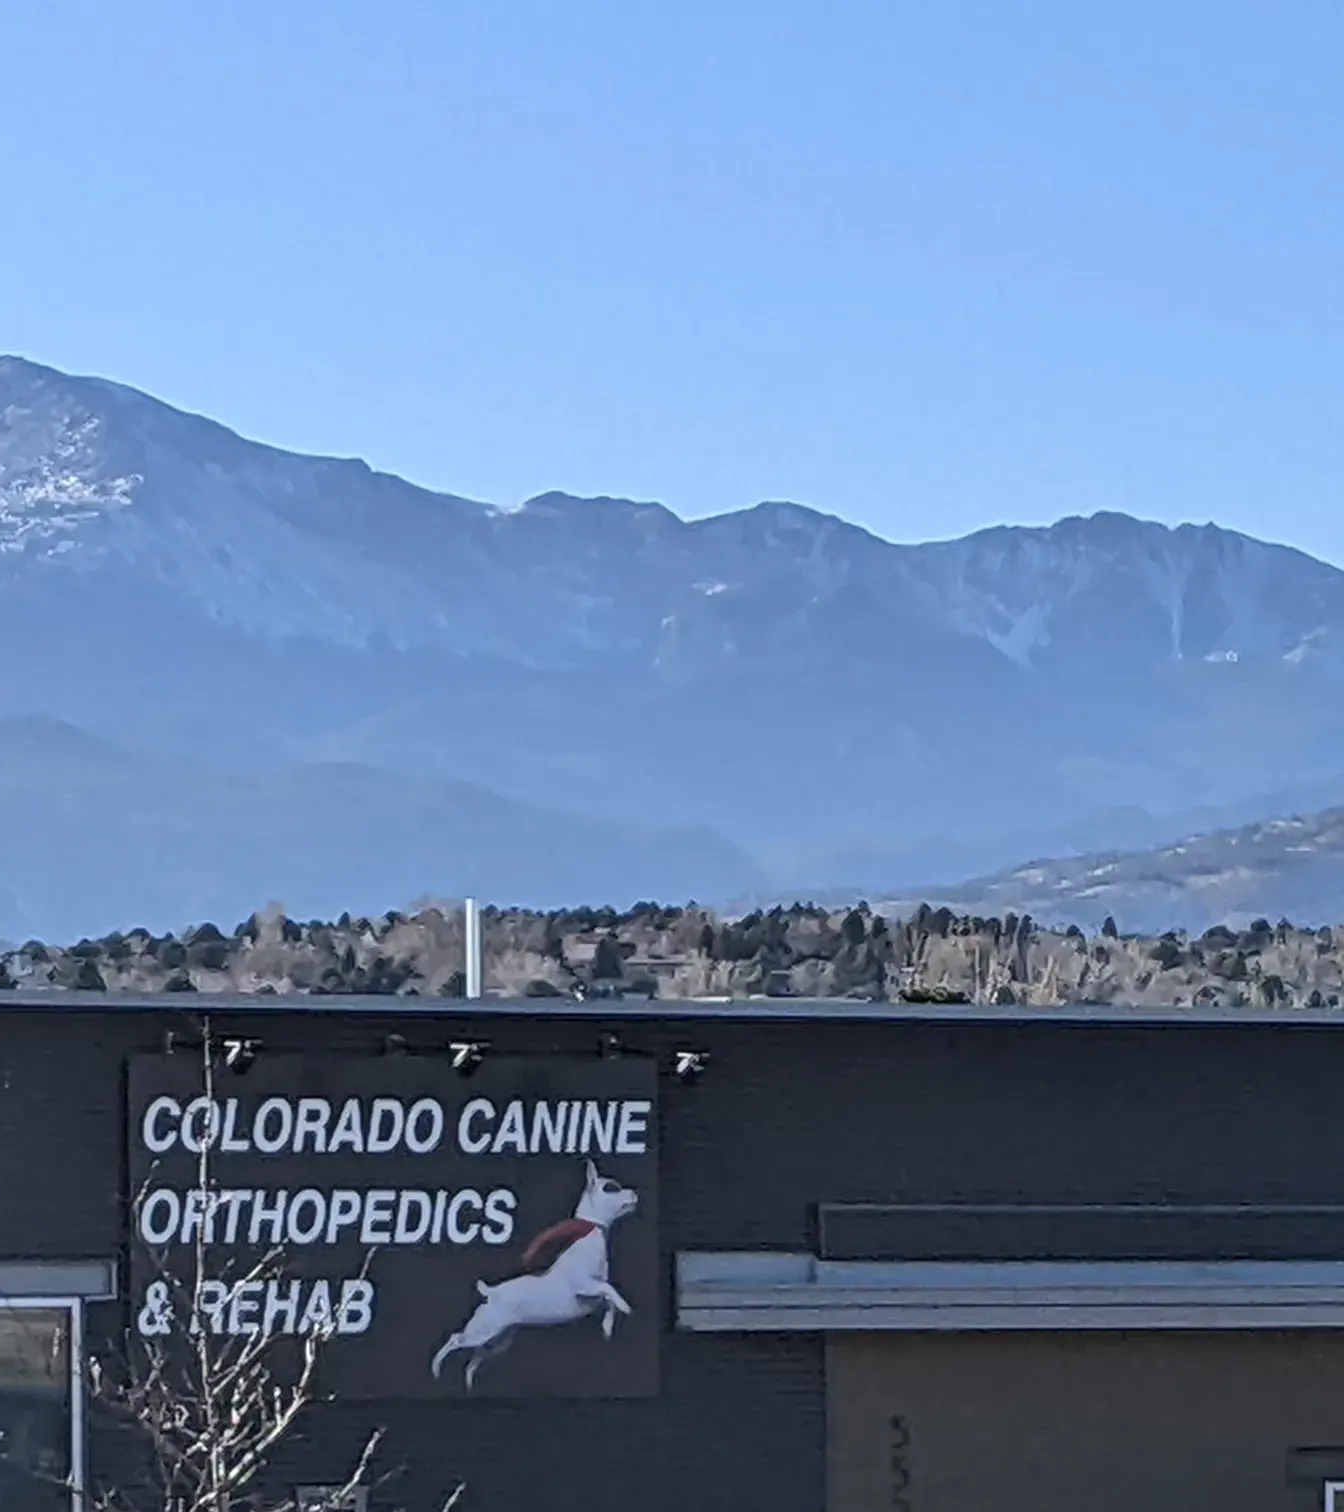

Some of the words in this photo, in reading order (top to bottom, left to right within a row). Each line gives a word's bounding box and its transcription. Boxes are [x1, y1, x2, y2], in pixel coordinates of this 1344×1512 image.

[142, 1097, 444, 1153] COLORADO
[457, 1099, 652, 1155] CANINE
[138, 1188, 517, 1245] ORTHOPEDICS
[137, 1280, 172, 1336] &
[189, 1280, 374, 1335] REHAB
